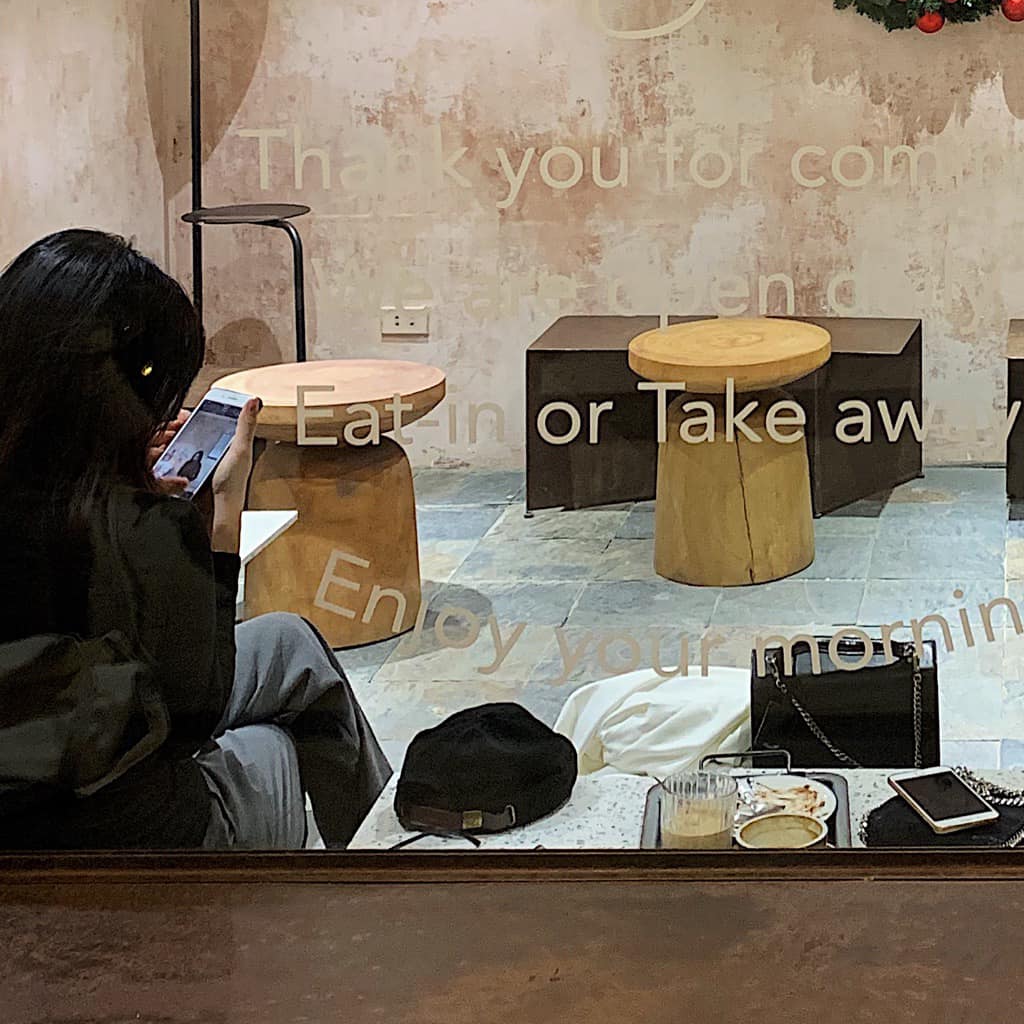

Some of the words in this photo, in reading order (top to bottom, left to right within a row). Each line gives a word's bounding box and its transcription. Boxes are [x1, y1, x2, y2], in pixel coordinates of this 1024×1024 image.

[495, 144, 629, 209] you
[655, 124, 763, 191] for
[296, 384, 505, 447] Eat-in
[536, 400, 614, 446] or
[637, 377, 807, 445] Take
[834, 398, 1022, 459] awy
[313, 548, 528, 675] Enjoy
[550, 626, 726, 686] your
